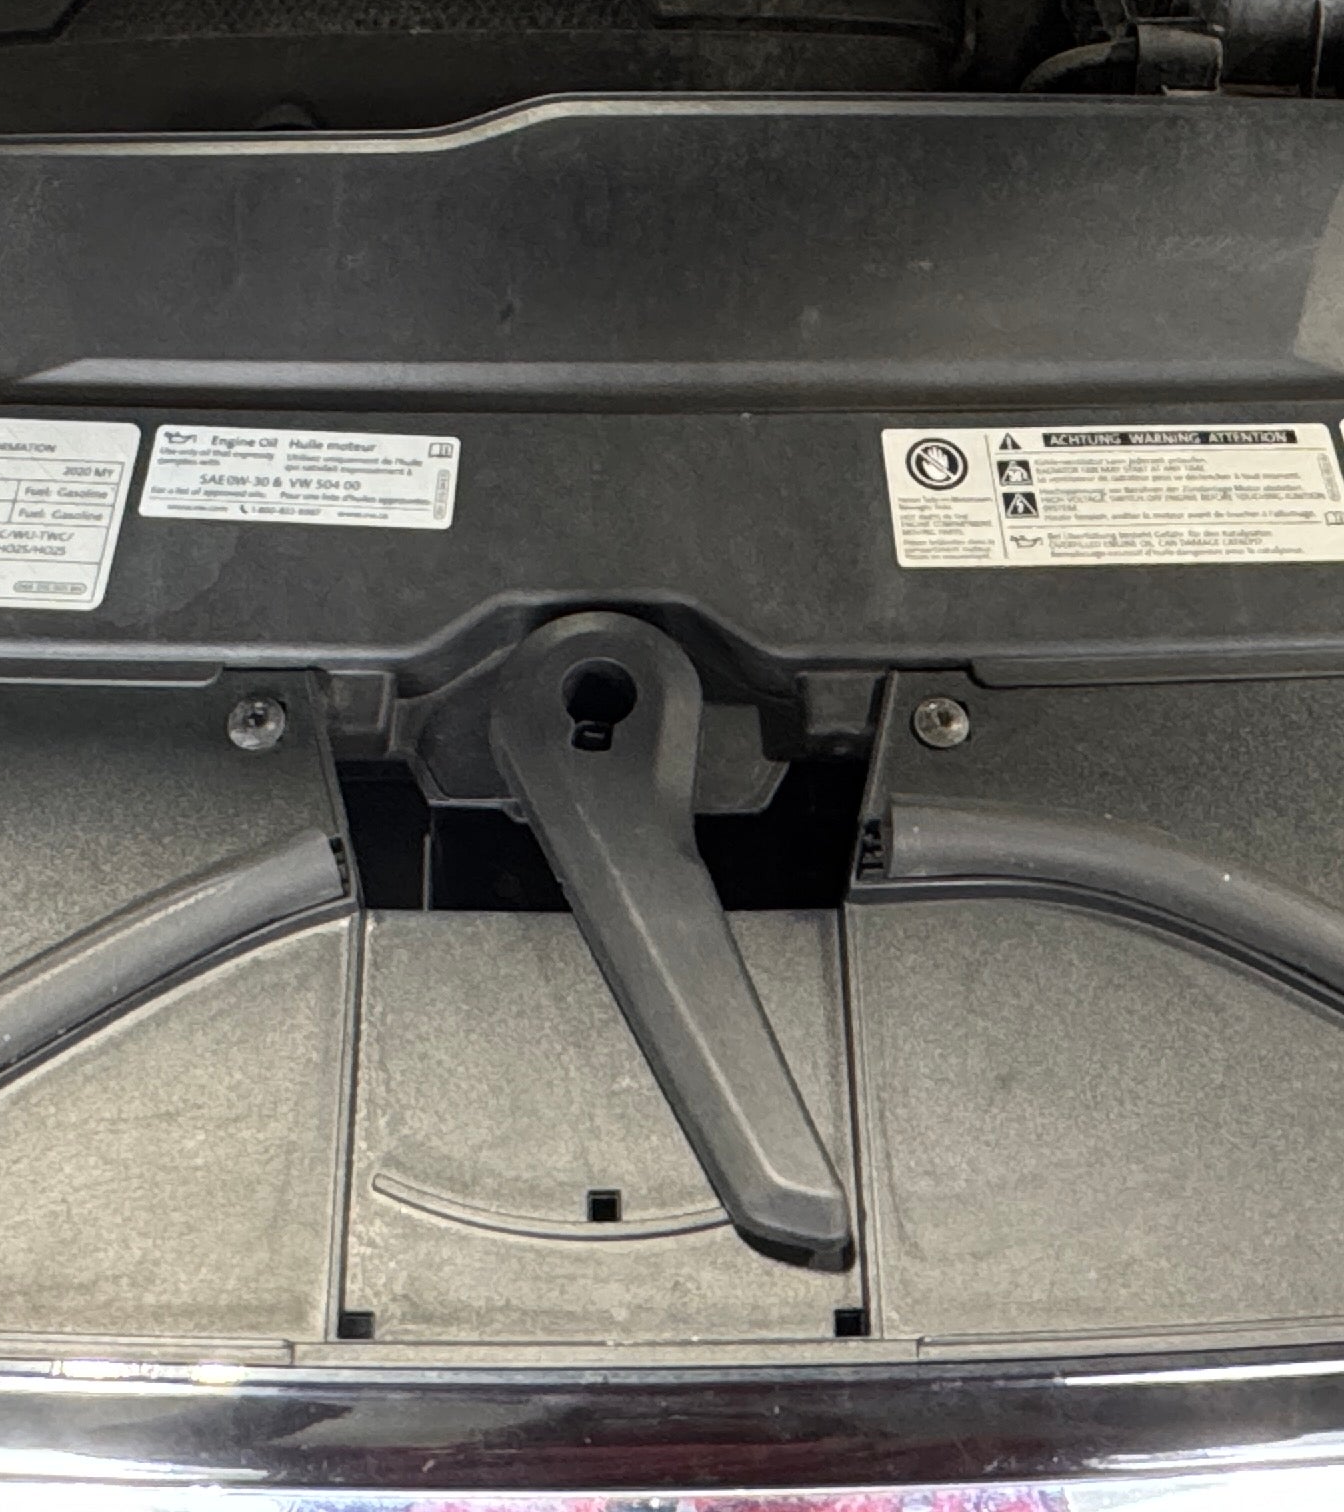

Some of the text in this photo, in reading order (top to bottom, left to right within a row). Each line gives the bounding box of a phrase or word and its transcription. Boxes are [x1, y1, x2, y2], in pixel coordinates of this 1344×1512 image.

[211, 435, 278, 450] Engine Oil
[289, 438, 377, 453] Huile moteur
[1050, 431, 1288, 447] ACHTUNG WARNING ATTENTION
[62, 466, 91, 477] 2020
[200, 473, 225, 485] SAE
[289, 477, 315, 489] VW
[316, 479, 340, 491] 504
[343, 480, 363, 492] 00
[24, 485, 109, 500] Fuel: Gasoline
[18, 507, 104, 522] Fuel: Gasoline
